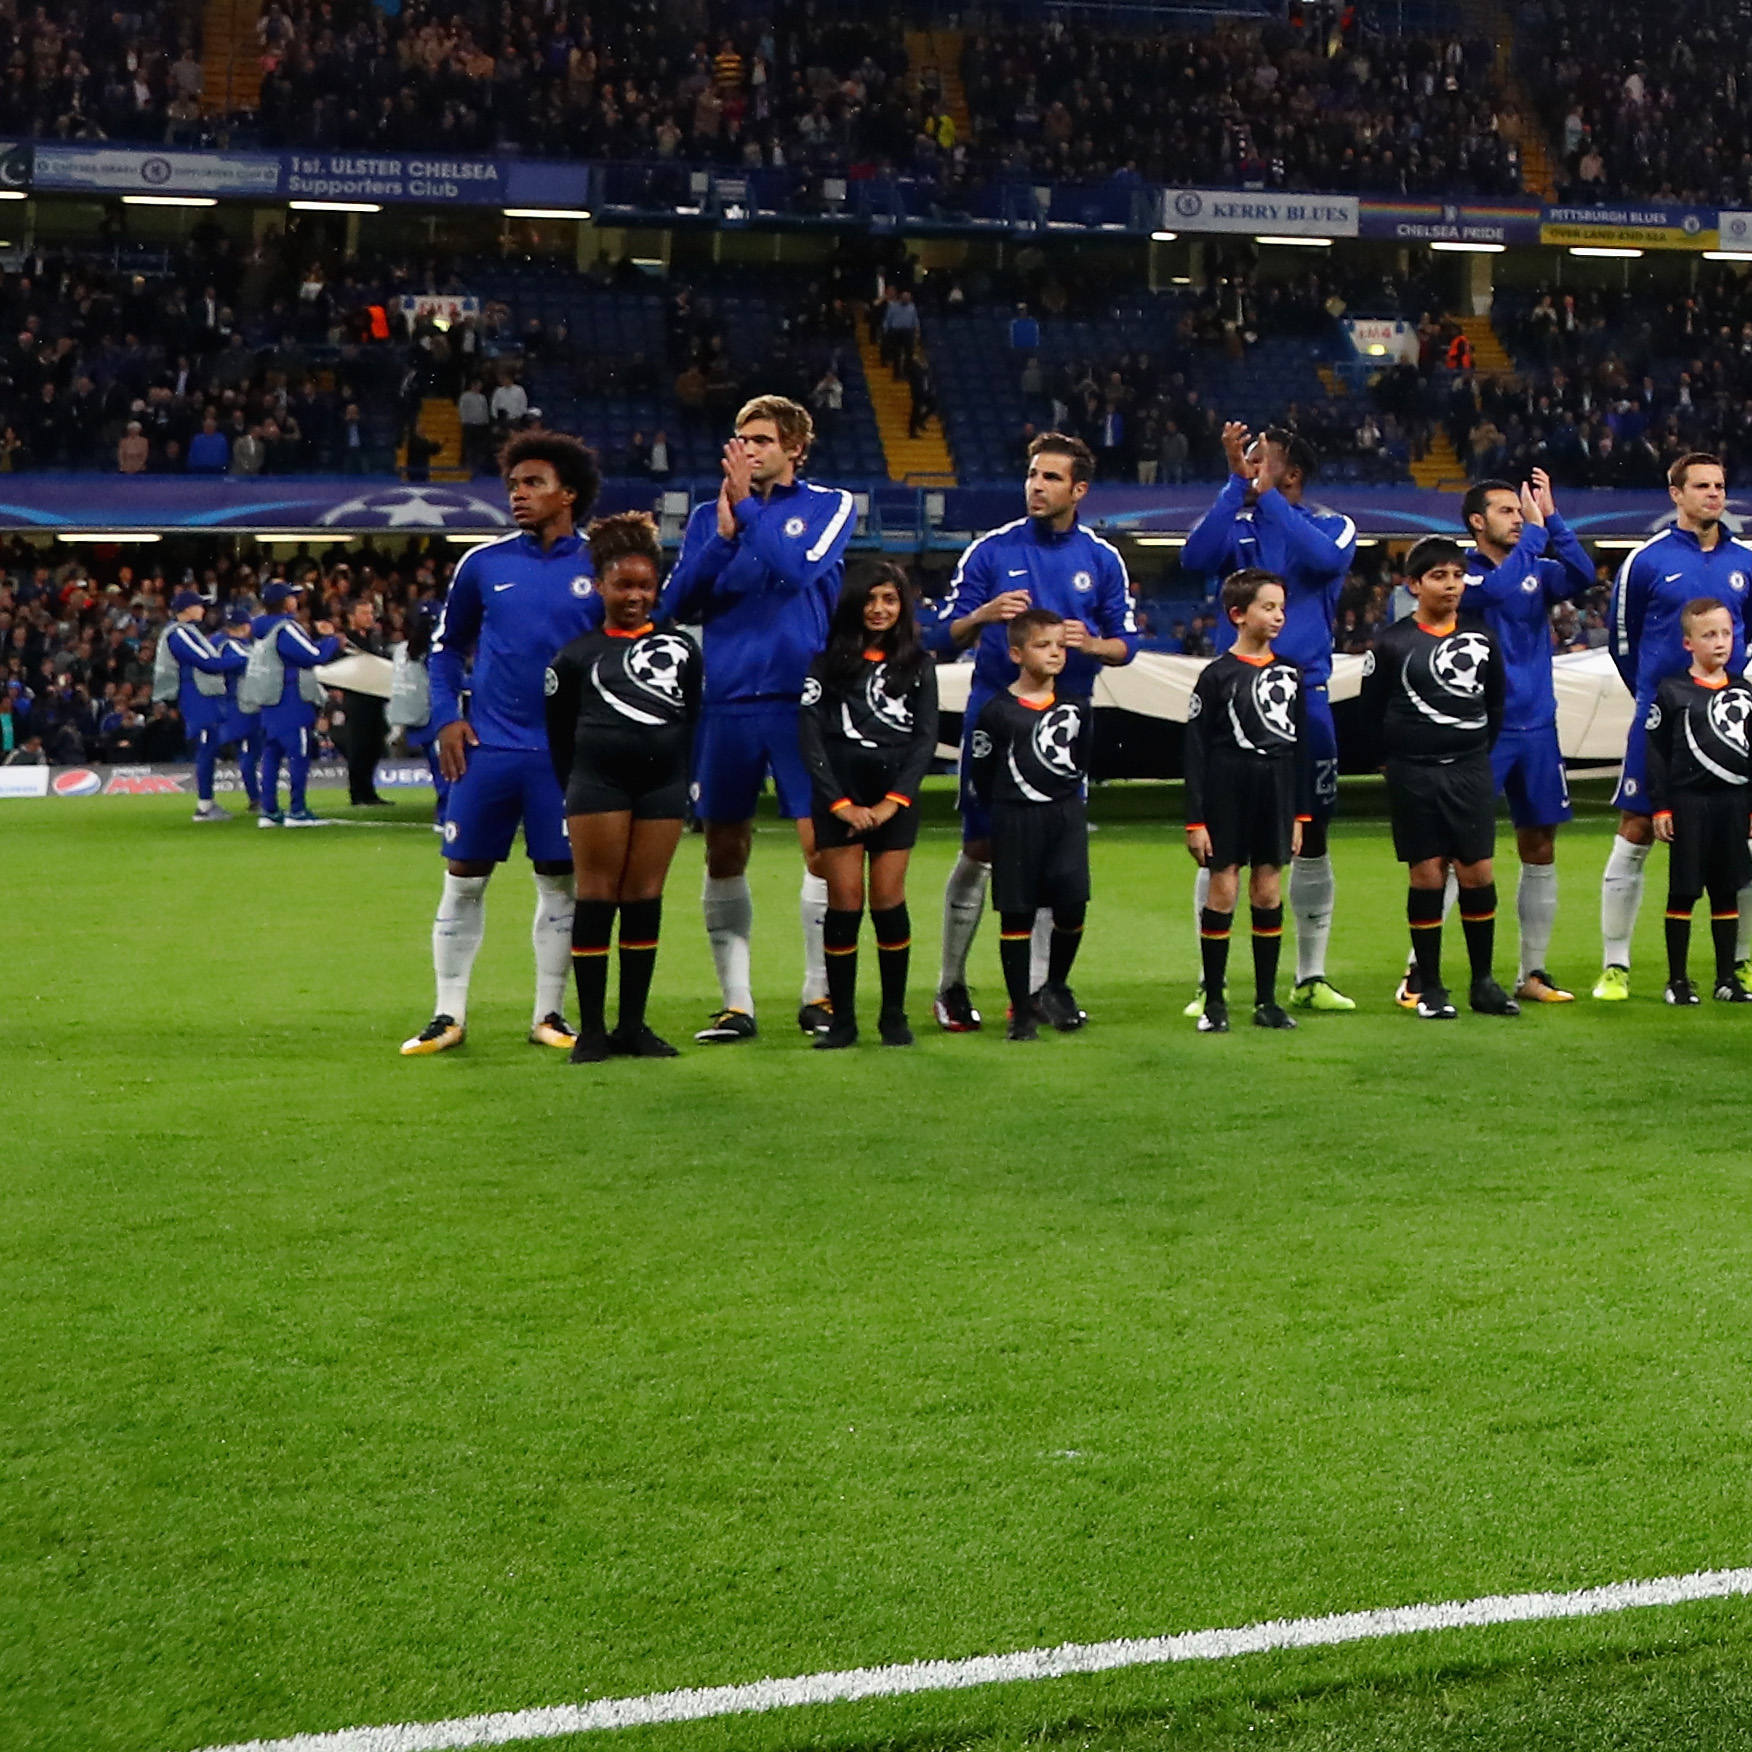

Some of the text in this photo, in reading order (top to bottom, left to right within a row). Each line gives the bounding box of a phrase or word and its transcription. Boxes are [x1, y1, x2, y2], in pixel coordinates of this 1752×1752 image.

[330, 157, 402, 176] ULSTER
[408, 161, 498, 181] CHELSEA
[289, 175, 459, 197] Supporters Club
[1213, 203, 1349, 222] KERRY BLUES
[1551, 208, 1667, 224] PITTSBURGH BLUES
[1397, 223, 1505, 240] CHELSEA PRIDE
